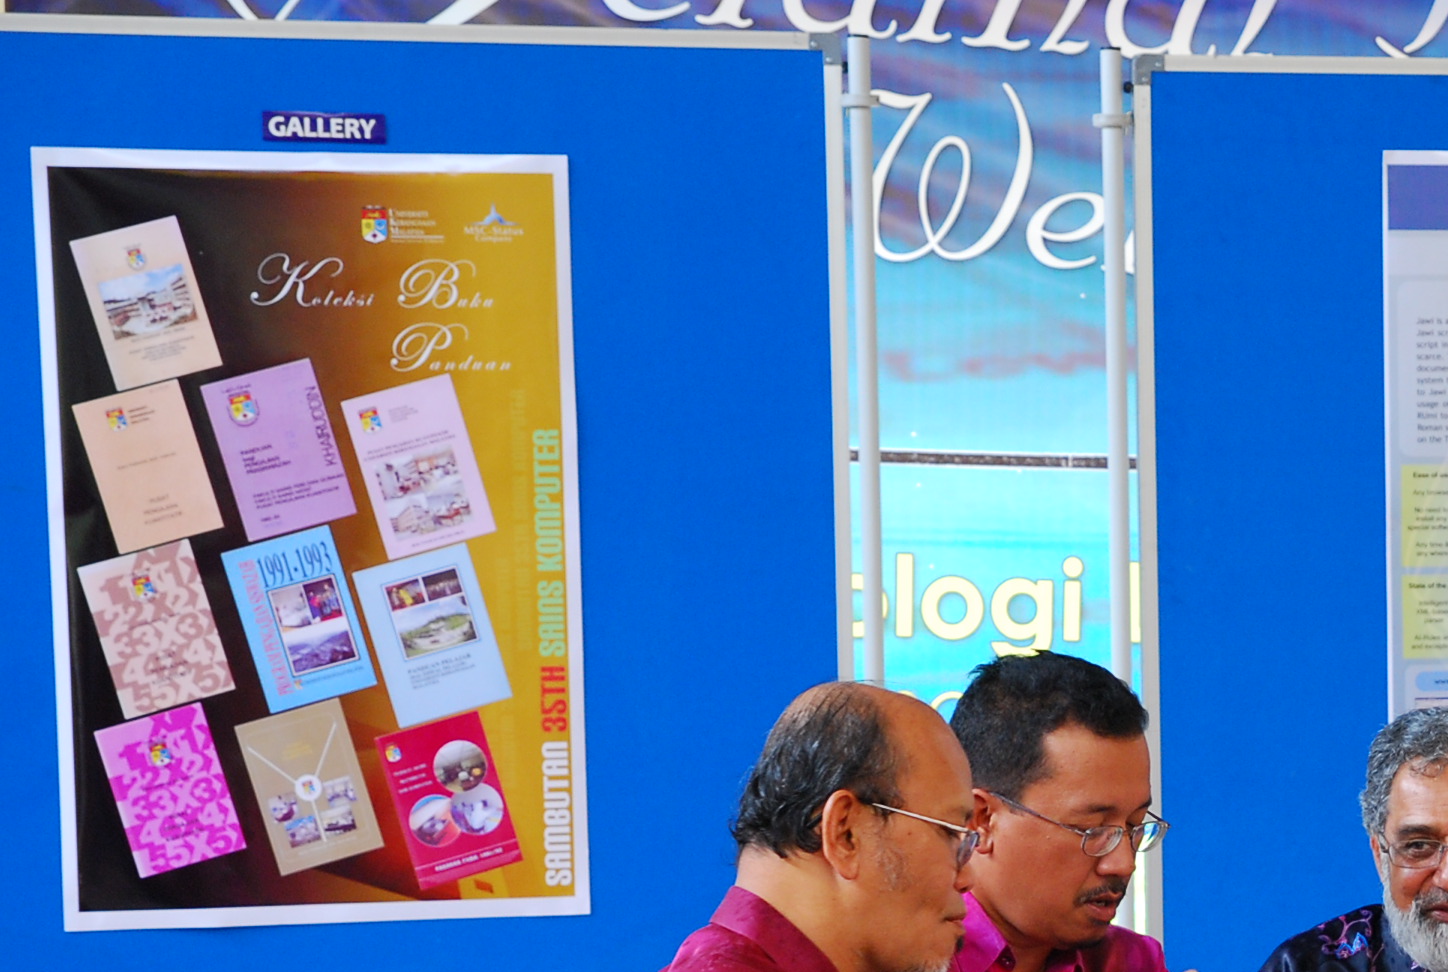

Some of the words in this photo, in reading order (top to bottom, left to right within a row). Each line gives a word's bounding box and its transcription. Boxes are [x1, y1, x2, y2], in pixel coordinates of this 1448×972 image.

[268, 116, 376, 140] GALLERY
[249, 252, 374, 308] Koleksi
[397, 258, 493, 310] Buku
[389, 321, 511, 372] Panduan
[532, 429, 565, 571] KOMPUTER
[538, 579, 566, 657] SAINS
[541, 741, 573, 886] SAMBUTAN
